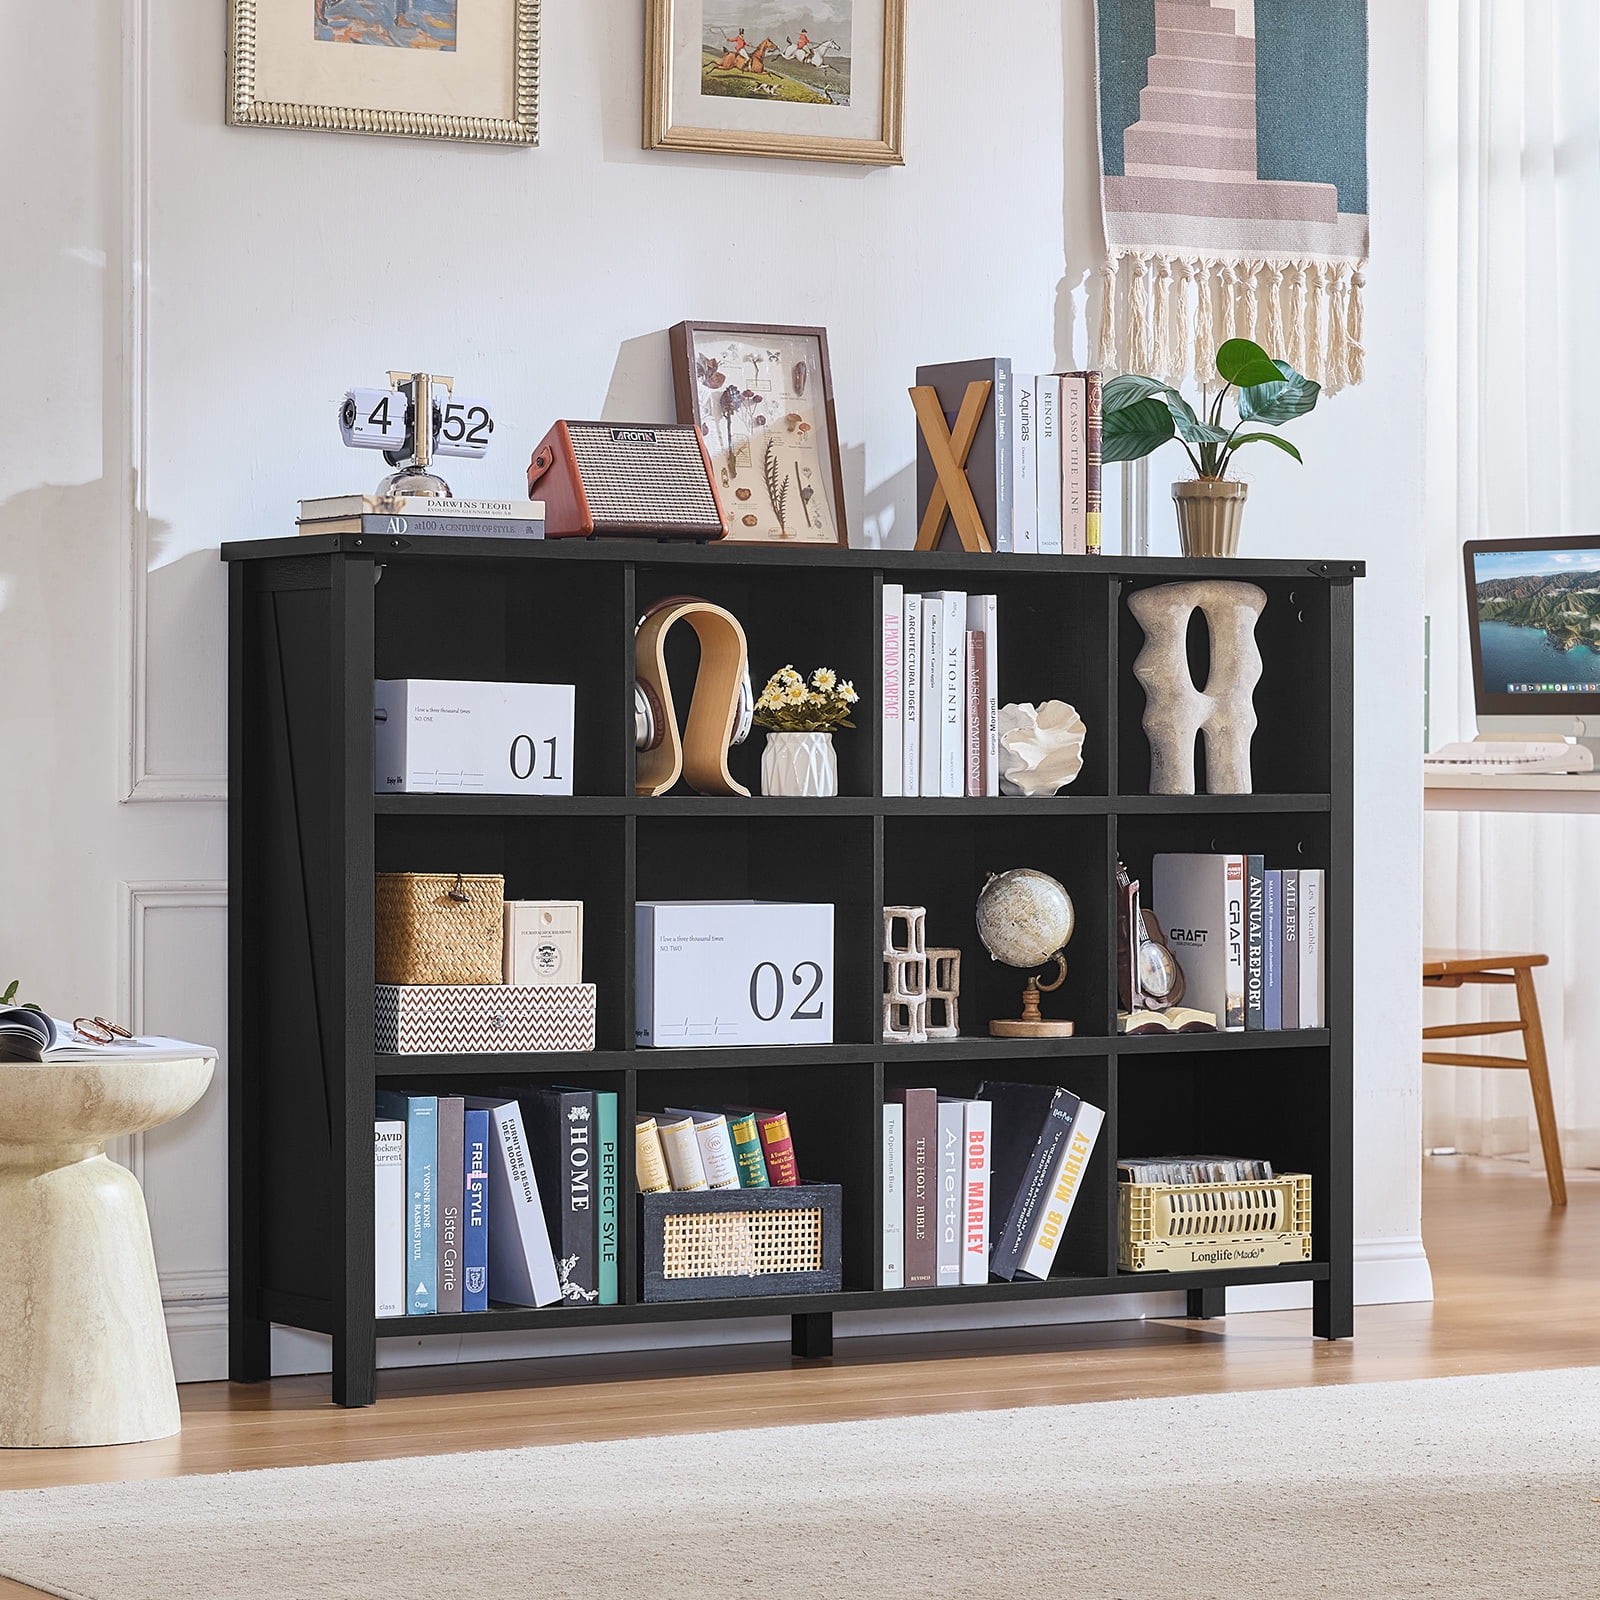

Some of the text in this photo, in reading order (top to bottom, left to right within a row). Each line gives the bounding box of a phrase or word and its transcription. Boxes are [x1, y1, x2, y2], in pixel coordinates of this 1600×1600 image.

[368, 397, 489, 444] 4 52
[998, 394, 1006, 417] good
[1019, 389, 1031, 442] Aquinas
[1044, 392, 1052, 438] RENOIR
[1070, 389, 1078, 514] PICASSO THE LINE
[387, 517, 408, 534] AD
[414, 521, 437, 531] at100
[446, 524, 481, 533] CENTURY
[482, 525, 493, 533] OF
[493, 526, 515, 534] STYLE
[427, 500, 512, 510] DARWINS TEORI
[885, 614, 899, 719] AL PACINO SCARFACE
[908, 615, 916, 688] ARCHITECTURAL
[908, 690, 916, 722] DIGEST
[948, 648, 957, 724] KINFOLK
[971, 669, 980, 704] MUSIC
[509, 734, 562, 780] 01
[971, 718, 980, 782] SYMPHONY
[1170, 928, 1208, 942] CRAFT
[1230, 900, 1240, 966] CRAFT
[1286, 879, 1296, 942] MILLERS
[1249, 876, 1262, 1010] ANNUAL REPORT
[750, 961, 823, 1021] 02
[374, 1132, 402, 1141] DAVID
[376, 1154, 402, 1162] urrent
[501, 1121, 521, 1181] IDEA BOOK08
[508, 1118, 533, 1203] FURNITURE DESIGN
[1036, 1149, 1049, 1170] THEN
[471, 1142, 482, 1226] FREE STYLE
[570, 1126, 589, 1211] HOME
[916, 1138, 925, 1239] THE HOLY BIBLE
[945, 1128, 957, 1243] Arletta
[968, 1131, 984, 1254] BOB MARLEY
[1026, 1174, 1039, 1197] WANT
[1038, 1211, 1064, 1250] BOB
[1055, 1131, 1090, 1203] MARLEY
[414, 1204, 422, 1238] RASMUS
[603, 1142, 615, 1262] PERFECT SYLE
[1023, 1197, 1030, 1206] TO
[414, 1239, 422, 1260] JUUL
[444, 1208, 457, 1291] Sister Carrie
[1191, 1249, 1232, 1263] Longlife
